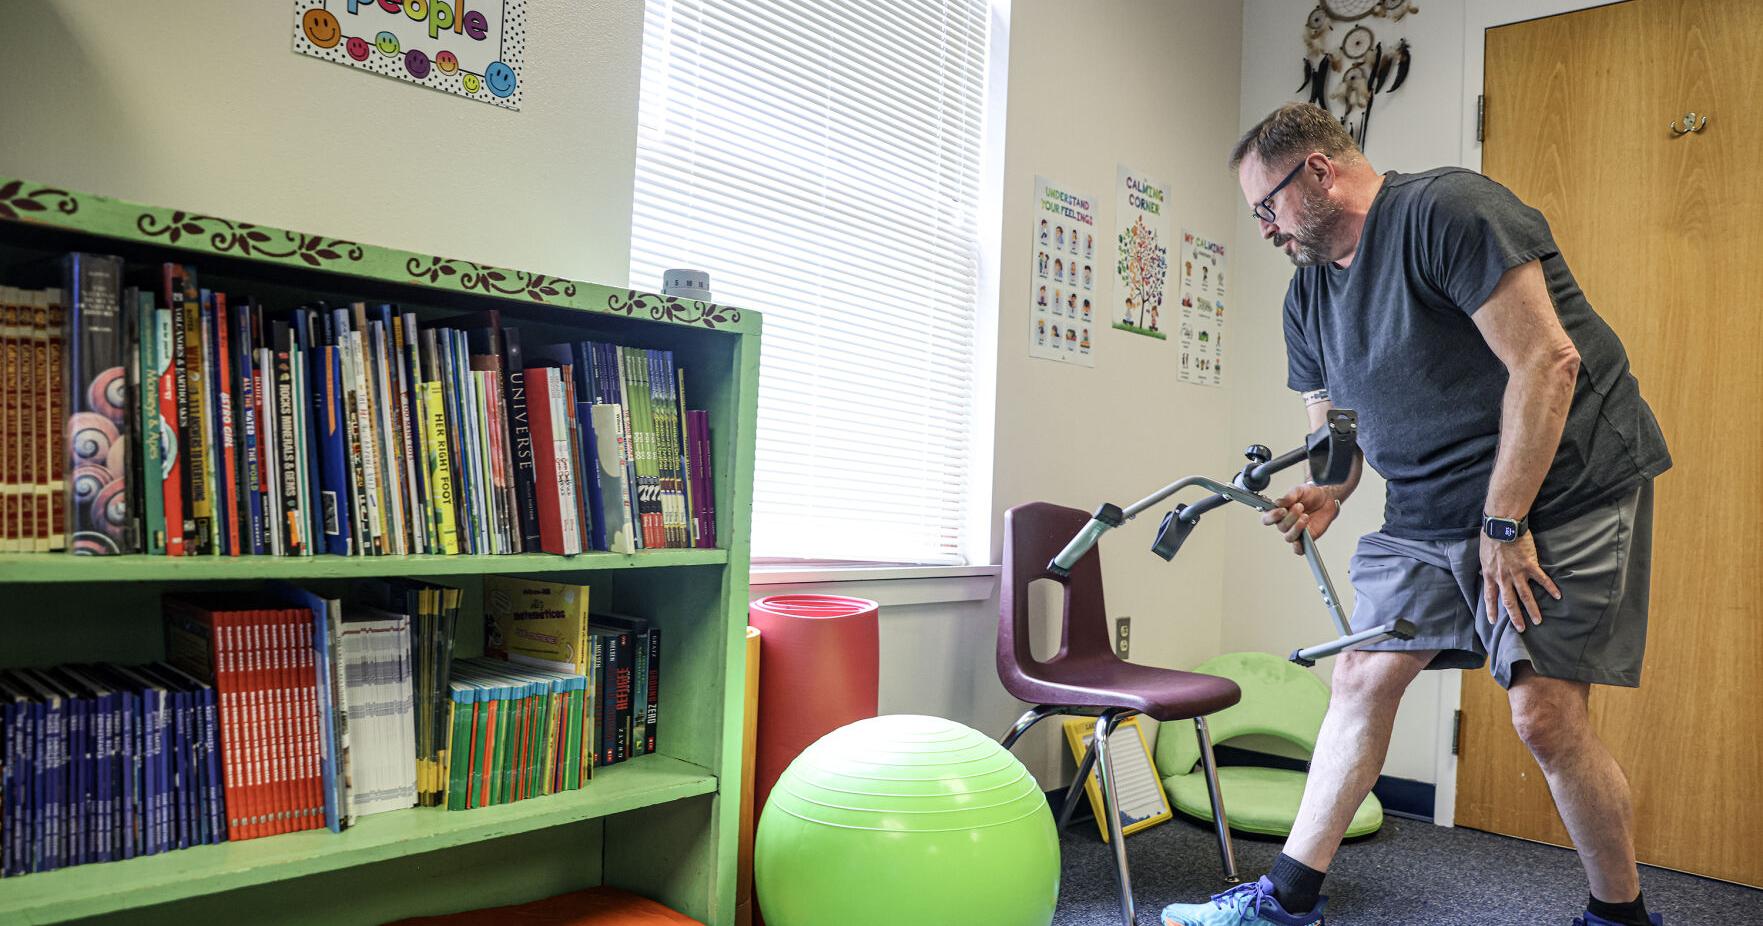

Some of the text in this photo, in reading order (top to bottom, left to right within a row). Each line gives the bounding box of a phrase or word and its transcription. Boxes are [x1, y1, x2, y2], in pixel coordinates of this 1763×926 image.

[1046, 186, 1089, 210] UNDERSTAND
[1126, 177, 1163, 202] CALMING
[1040, 198, 1093, 226] YOUR FEELINGS
[1129, 194, 1160, 216] CORNER
[1196, 237, 1224, 256] CALMING
[176, 308, 185, 358] VOLCANOES
[145, 370, 158, 416] Monkeys
[176, 367, 188, 428] EARTHQUAKES
[279, 384, 292, 414] ROCKS
[221, 392, 234, 448] ASTRO GIRL
[510, 373, 532, 470] UNIVERSE
[147, 432, 160, 460] Apes
[281, 416, 295, 461] MINERALS
[248, 448, 256, 462] THE
[434, 414, 452, 504] HER RIGHT FOOT
[249, 464, 259, 492] WORLD
[285, 471, 296, 496] GEMS
[616, 667, 629, 710] REFUGEE
[648, 704, 657, 724] ZERO
